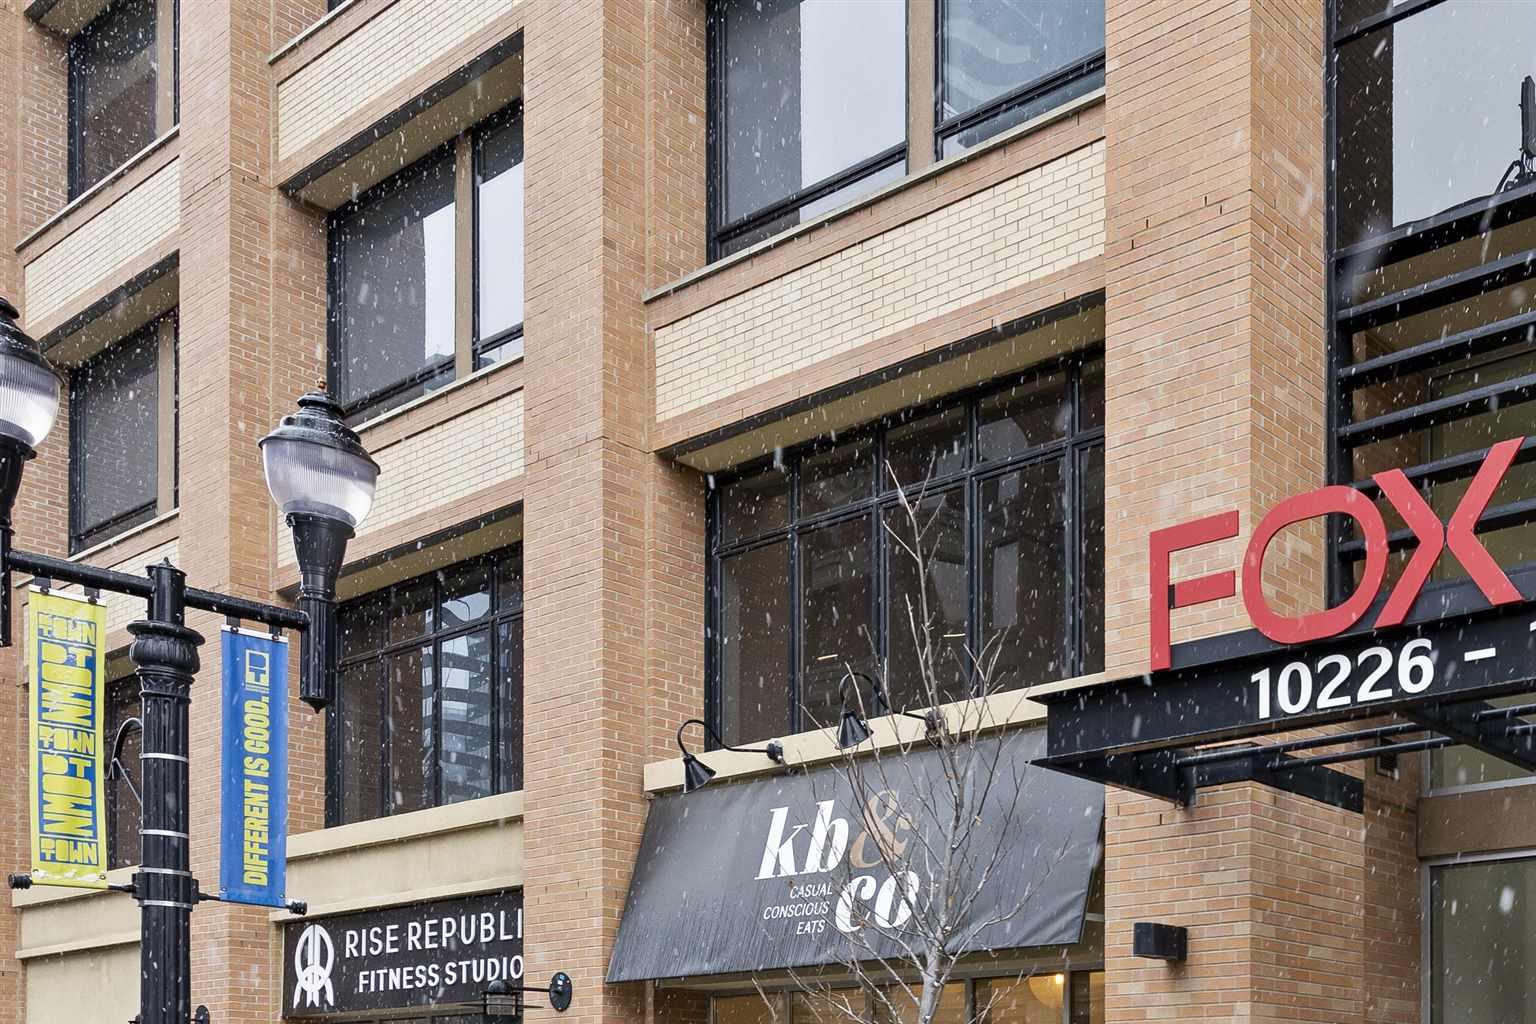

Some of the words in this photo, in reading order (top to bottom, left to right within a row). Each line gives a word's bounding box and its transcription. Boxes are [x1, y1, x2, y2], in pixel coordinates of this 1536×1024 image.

[1150, 436, 1526, 672] FOX
[1250, 638, 1435, 719] 10226
[243, 696, 270, 754] GOOD.
[243, 756, 270, 778] IS
[243, 779, 269, 886] DIFFERENT
[790, 882, 833, 899] CASUAL
[835, 871, 920, 932] co
[763, 902, 830, 919] CONSCIOUS
[796, 920, 825, 935] EATS
[345, 924, 399, 958] RISE
[359, 964, 440, 993] FITNESS
[444, 955, 523, 985] STUDIO
